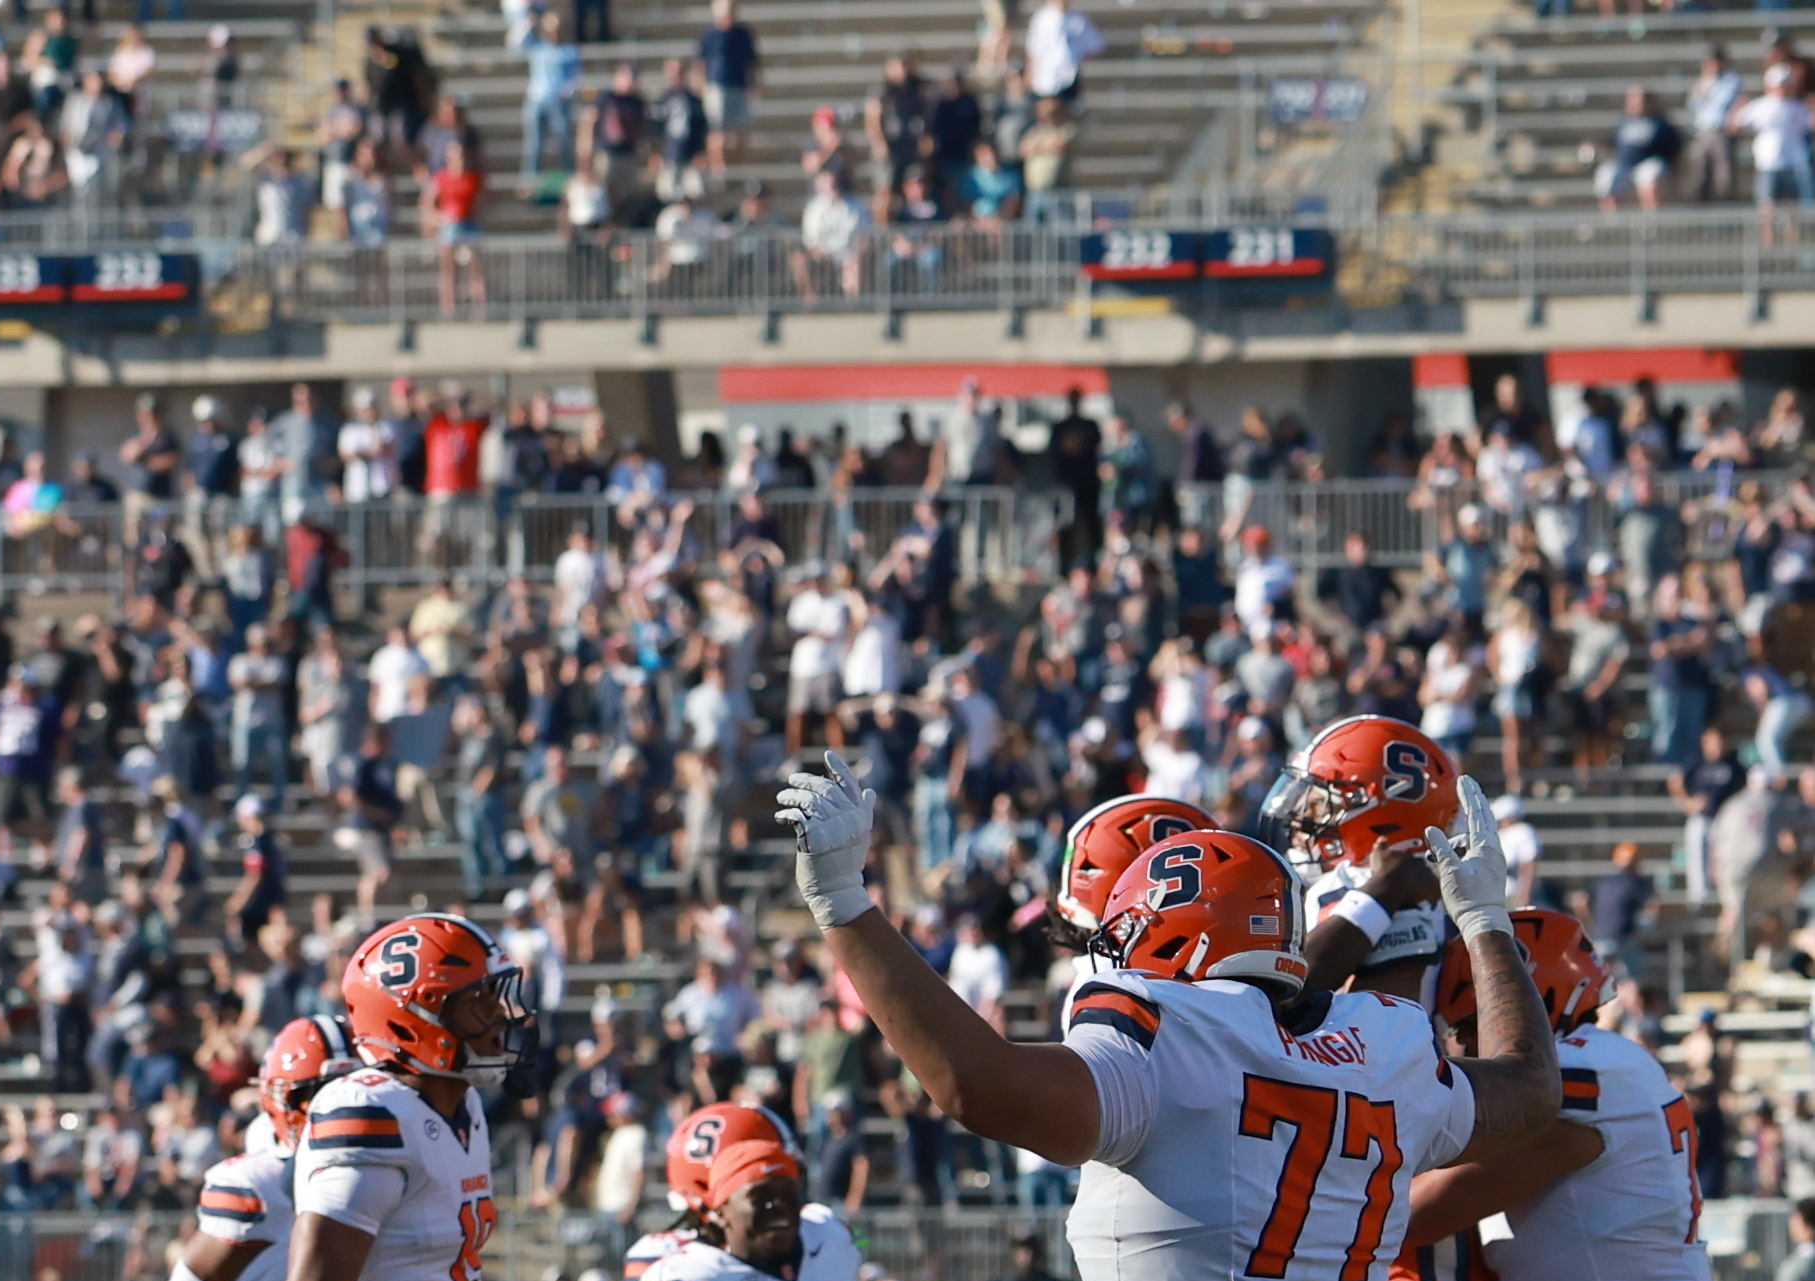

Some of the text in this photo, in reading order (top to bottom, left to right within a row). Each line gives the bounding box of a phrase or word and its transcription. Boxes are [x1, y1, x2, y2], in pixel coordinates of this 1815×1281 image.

[1384, 740, 1427, 803] S
[1147, 843, 1203, 911] S
[380, 931, 423, 988] S
[684, 1115, 727, 1164] S
